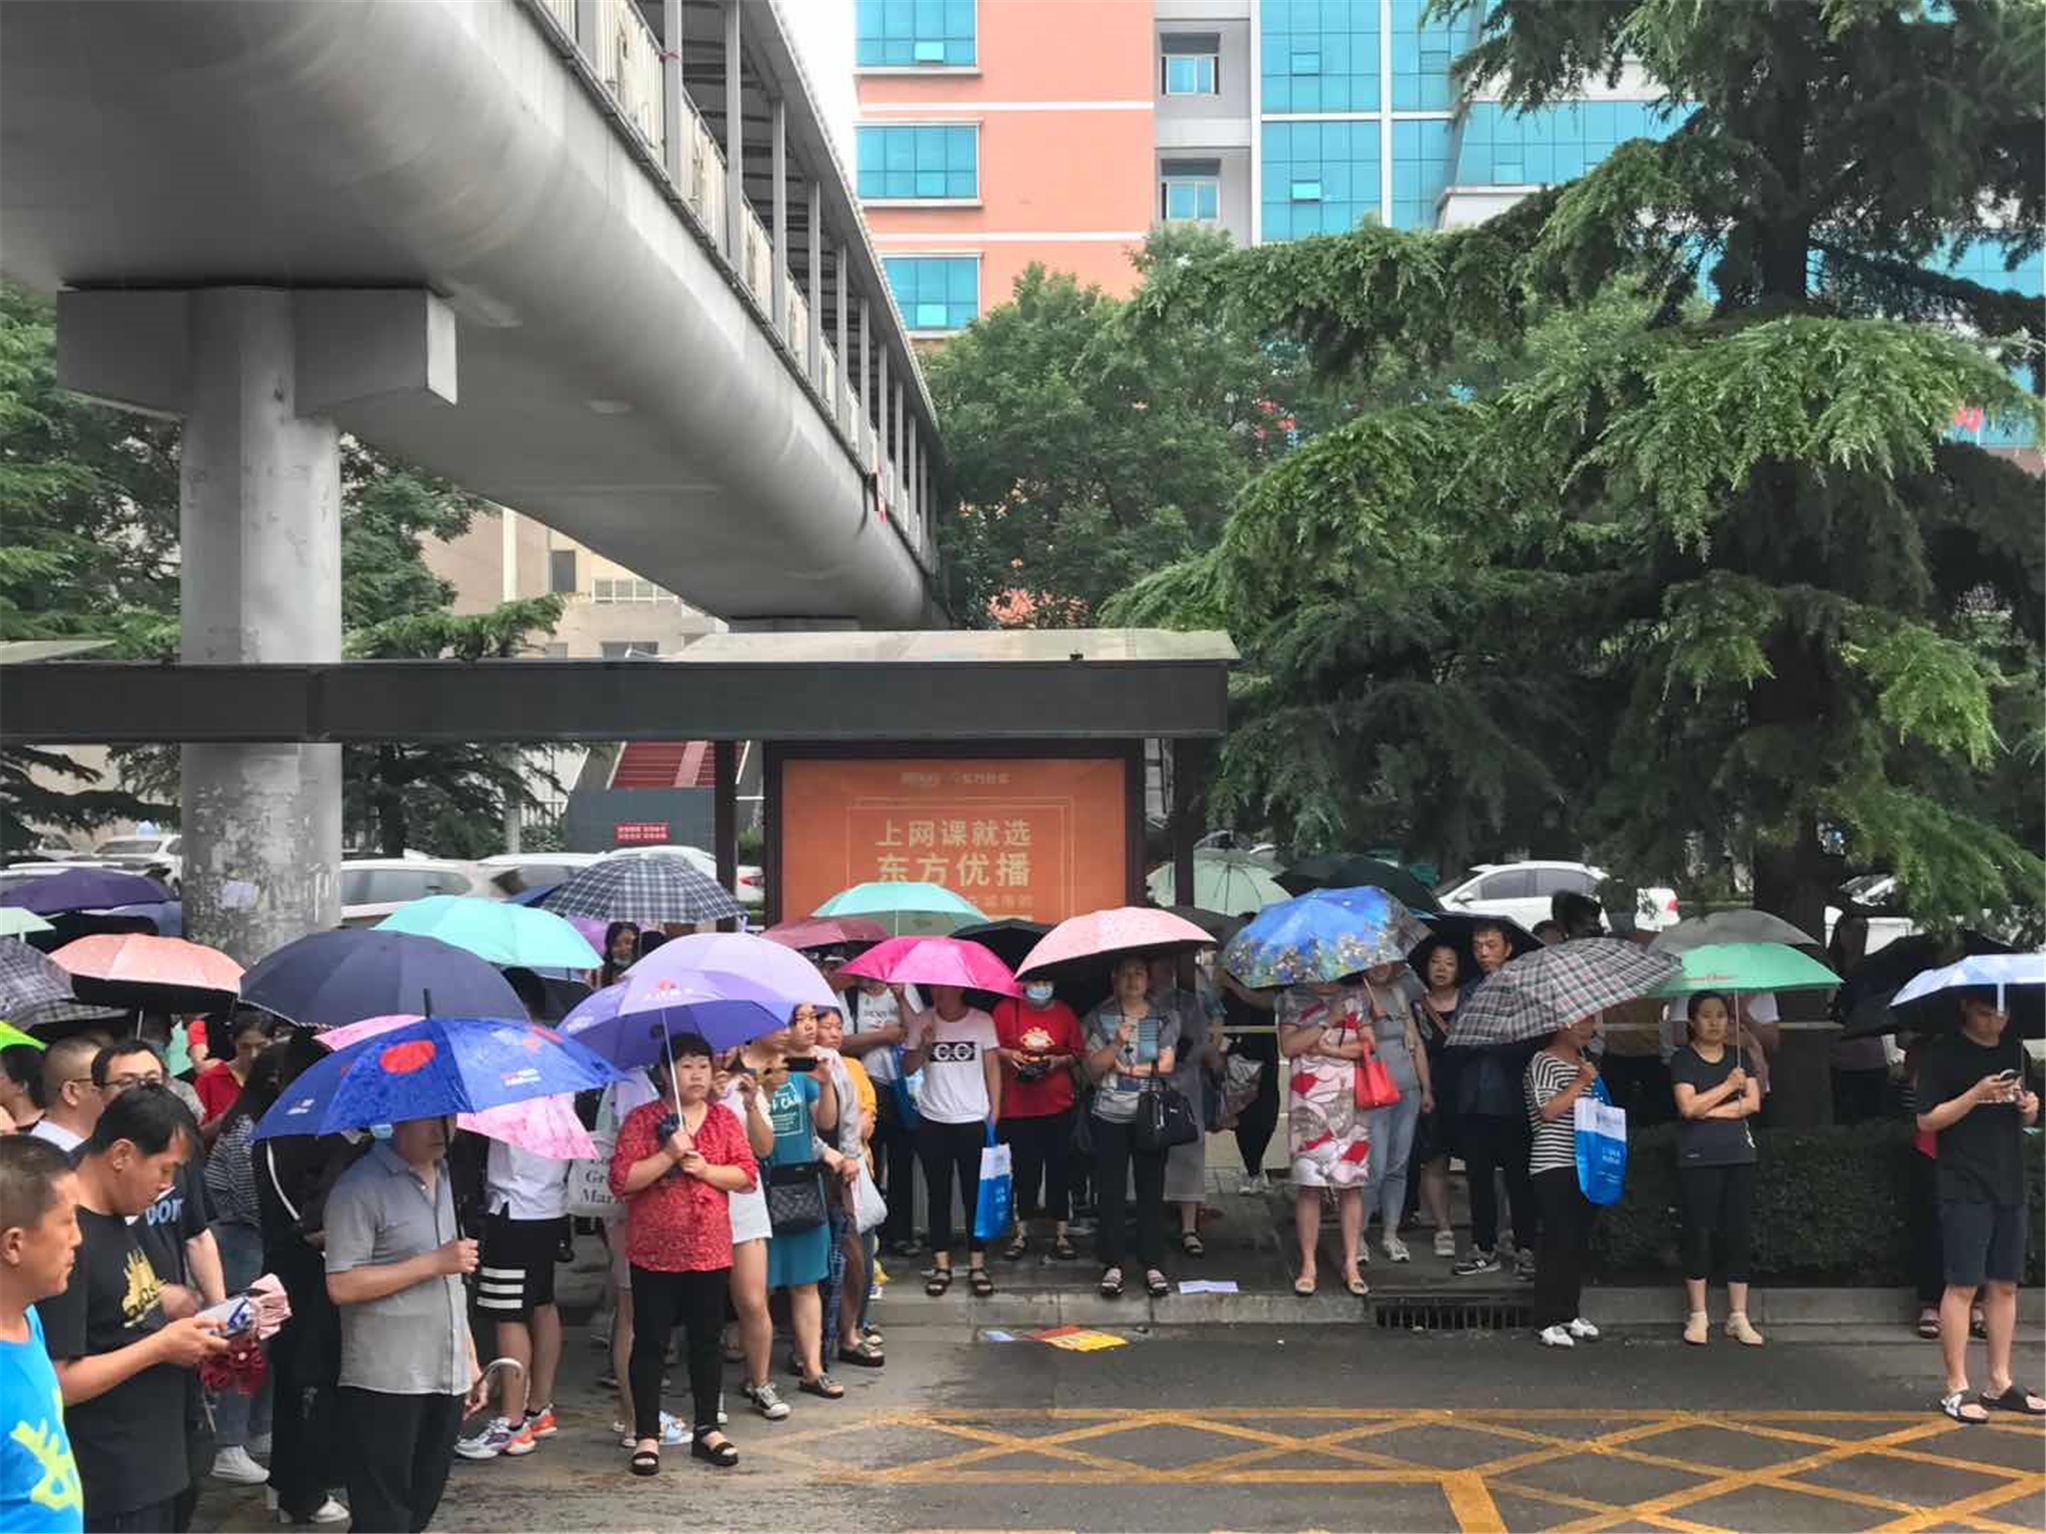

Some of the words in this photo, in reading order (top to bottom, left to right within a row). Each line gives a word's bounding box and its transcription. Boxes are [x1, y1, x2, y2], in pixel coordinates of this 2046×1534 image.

[875, 818, 1031, 848] 上网课就选
[877, 853, 1033, 886] 东方优播
